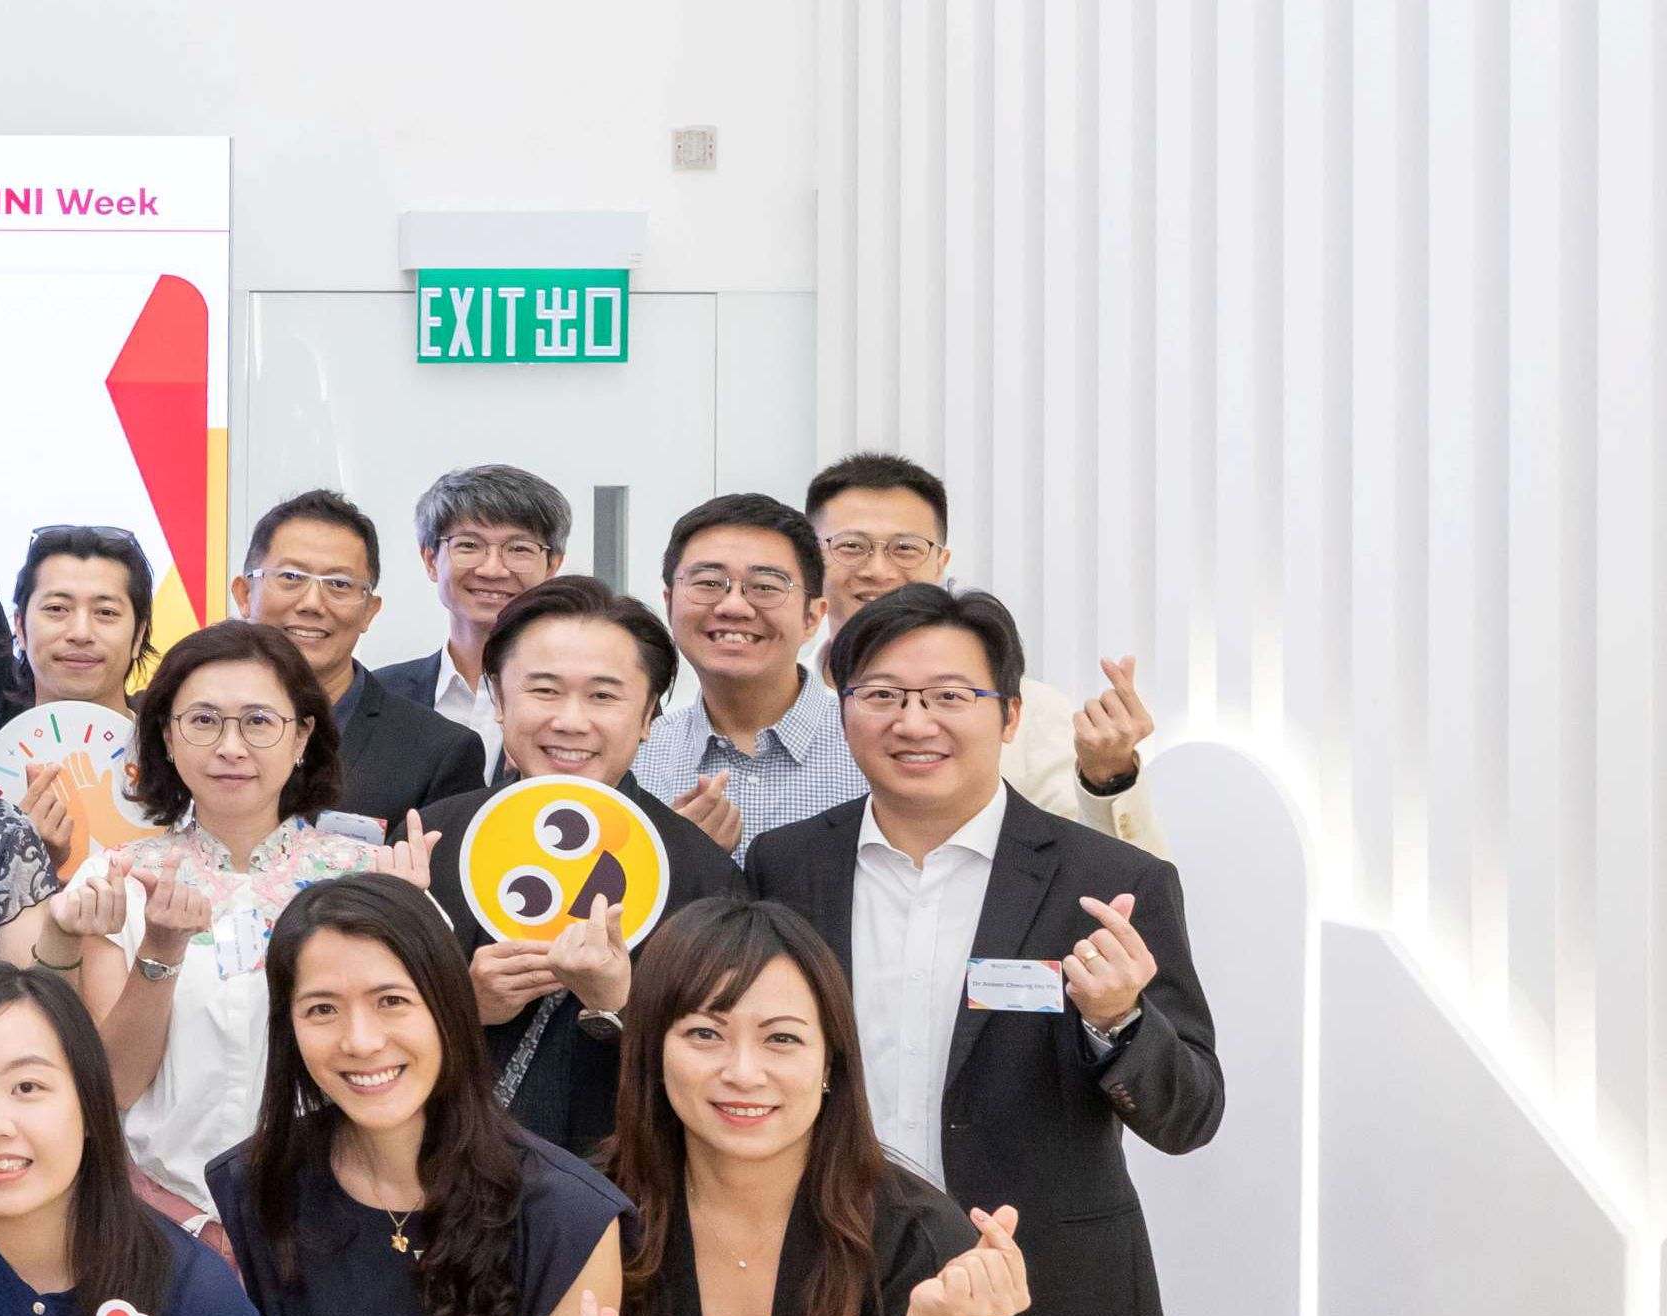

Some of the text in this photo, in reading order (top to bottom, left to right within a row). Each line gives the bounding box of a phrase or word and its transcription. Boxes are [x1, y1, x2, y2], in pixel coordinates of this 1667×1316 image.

[56, 187, 159, 216] Week
[419, 287, 526, 357] EXIT
[534, 287, 622, 357] 出口
